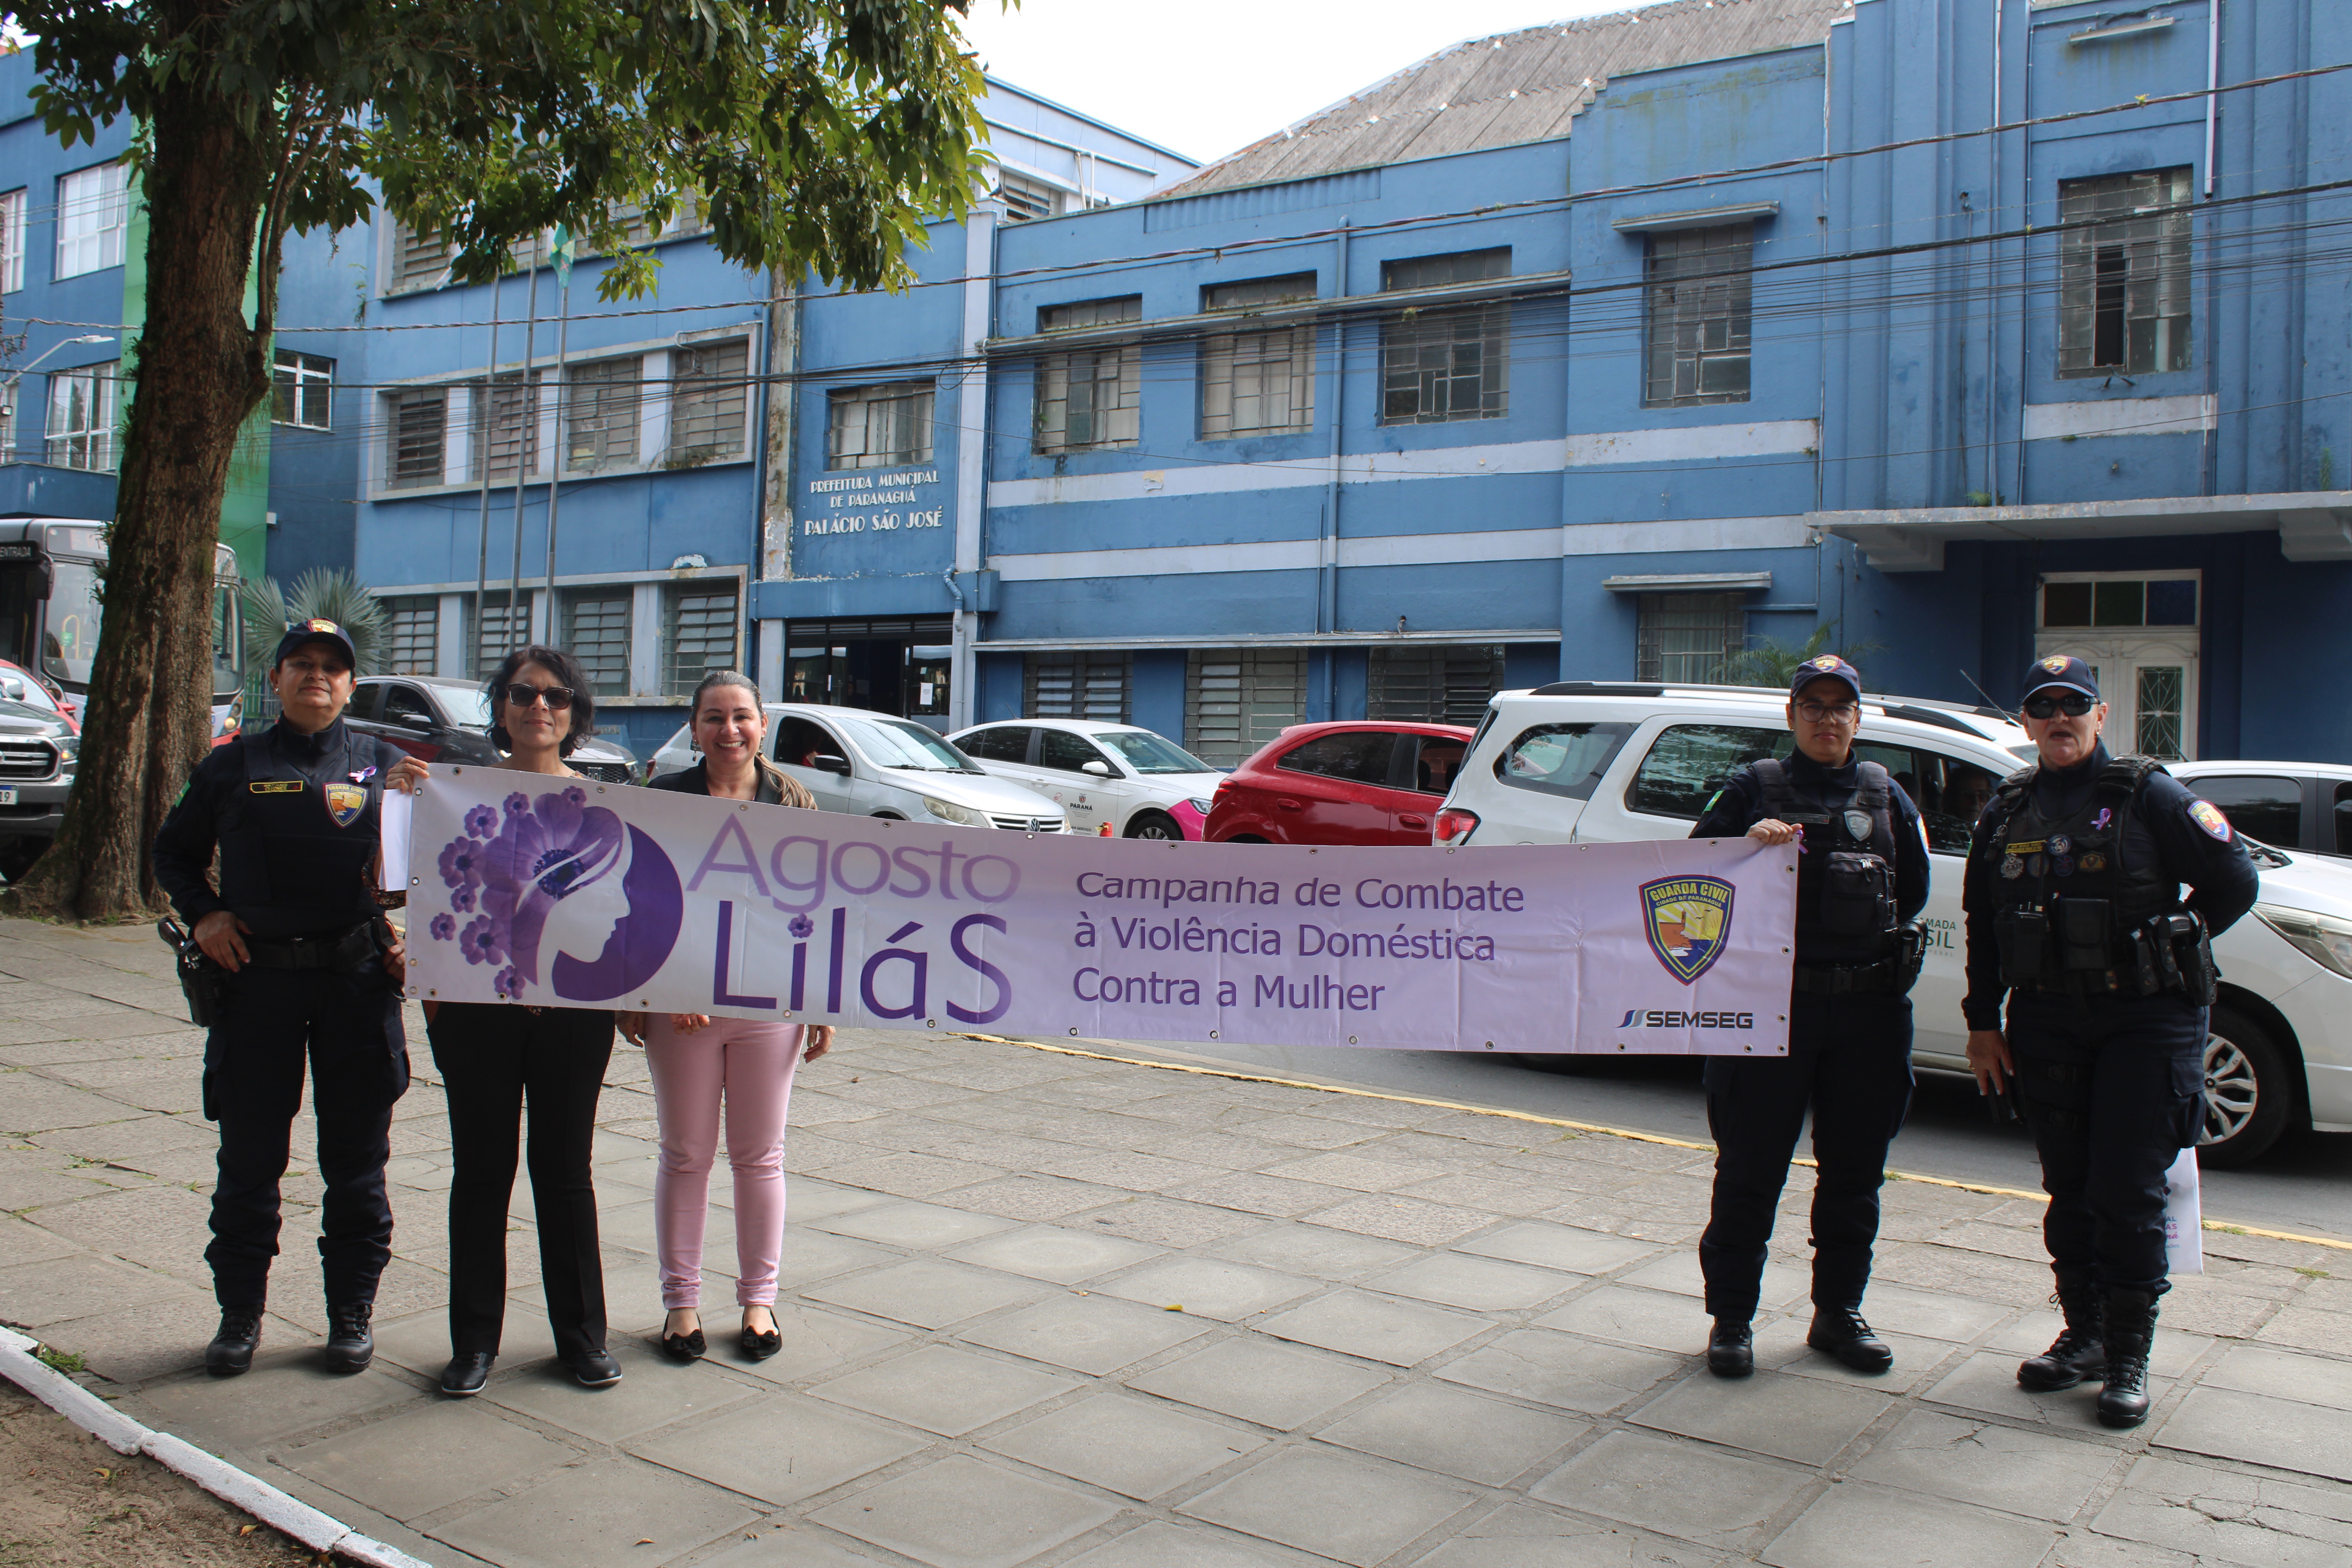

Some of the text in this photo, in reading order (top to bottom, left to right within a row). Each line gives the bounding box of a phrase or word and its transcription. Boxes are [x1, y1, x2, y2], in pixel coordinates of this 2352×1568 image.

[811, 471, 940, 494] PREFEITURA MUNICIPAL
[830, 485, 916, 508] DE PARANAGUÁ
[805, 505, 943, 535] PALÁCIO SÃO JOSÉ
[686, 812, 1021, 914] Agosto
[1076, 872, 1524, 912] Campanha de Combate
[1649, 883, 1729, 903] GUARDA CIVIL
[1655, 896, 1677, 907] CIDADE
[1688, 895, 1722, 908] PARANAGUÁ
[1922, 917, 1956, 930] MADA
[1074, 911, 1495, 961] à Violência Doméstica
[1073, 967, 1386, 1010] Contra a Mulher
[1646, 1011, 1753, 1029] SEMSEG
